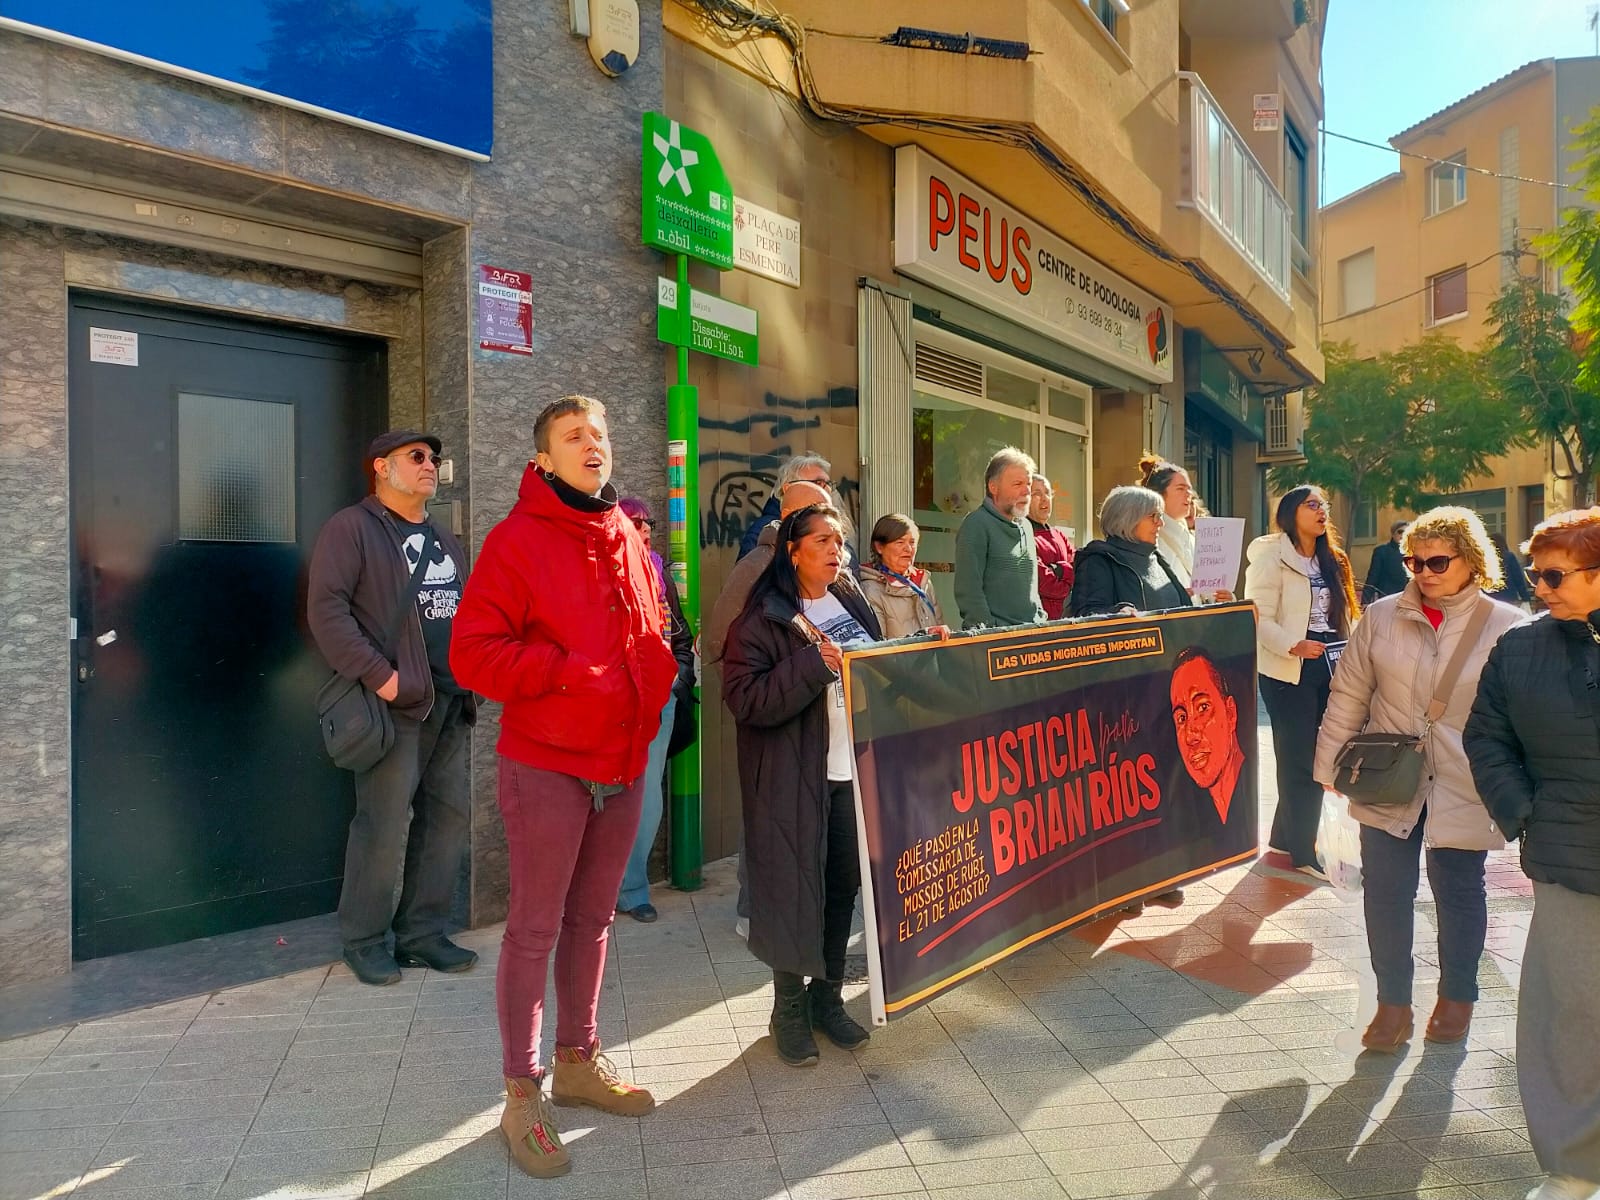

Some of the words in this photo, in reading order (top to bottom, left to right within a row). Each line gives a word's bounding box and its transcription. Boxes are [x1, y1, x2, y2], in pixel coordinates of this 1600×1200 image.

[658, 206, 718, 240] deixalleria
[748, 212, 783, 238] PLAÇA
[786, 228, 798, 244] DE
[929, 175, 1032, 296] PEUS
[756, 234, 781, 255] PERE
[740, 247, 794, 279] ESMENDIA
[482, 286, 518, 300] PROTEGIT
[661, 285, 674, 302] 29
[1038, 249, 1076, 286] CENTRE
[1079, 271, 1090, 294] DE
[1094, 280, 1141, 322] PODOLOGIA
[1078, 303, 1087, 320] 93
[692, 319, 731, 341] Dissabte:
[693, 333, 713, 349] 11.00
[718, 340, 737, 357] 11.50
[738, 346, 744, 359] h
[996, 655, 1018, 670] LAS
[1020, 651, 1051, 666] VIDAS
[1053, 643, 1107, 661] MIGRANTES
[1108, 636, 1156, 652] IMPORTAN
[952, 708, 1096, 813] JUSTICIA
[989, 777, 1087, 876] BRIAN
[1088, 752, 1161, 831] RÍOS
[895, 838, 922, 878] ¿QUÉ
[925, 825, 951, 859] PASÓ
[952, 823, 965, 846] EN
[966, 817, 979, 839] LA
[898, 846, 963, 895] COMISSARIA
[964, 838, 977, 860] DE
[904, 878, 944, 917] MOSSOS
[946, 869, 960, 893] DE
[961, 850, 985, 885] RUBÍ
[899, 918, 914, 942] EL
[916, 908, 929, 933] 21
[932, 899, 946, 923] DE
[948, 874, 990, 914] AGOSTO?
